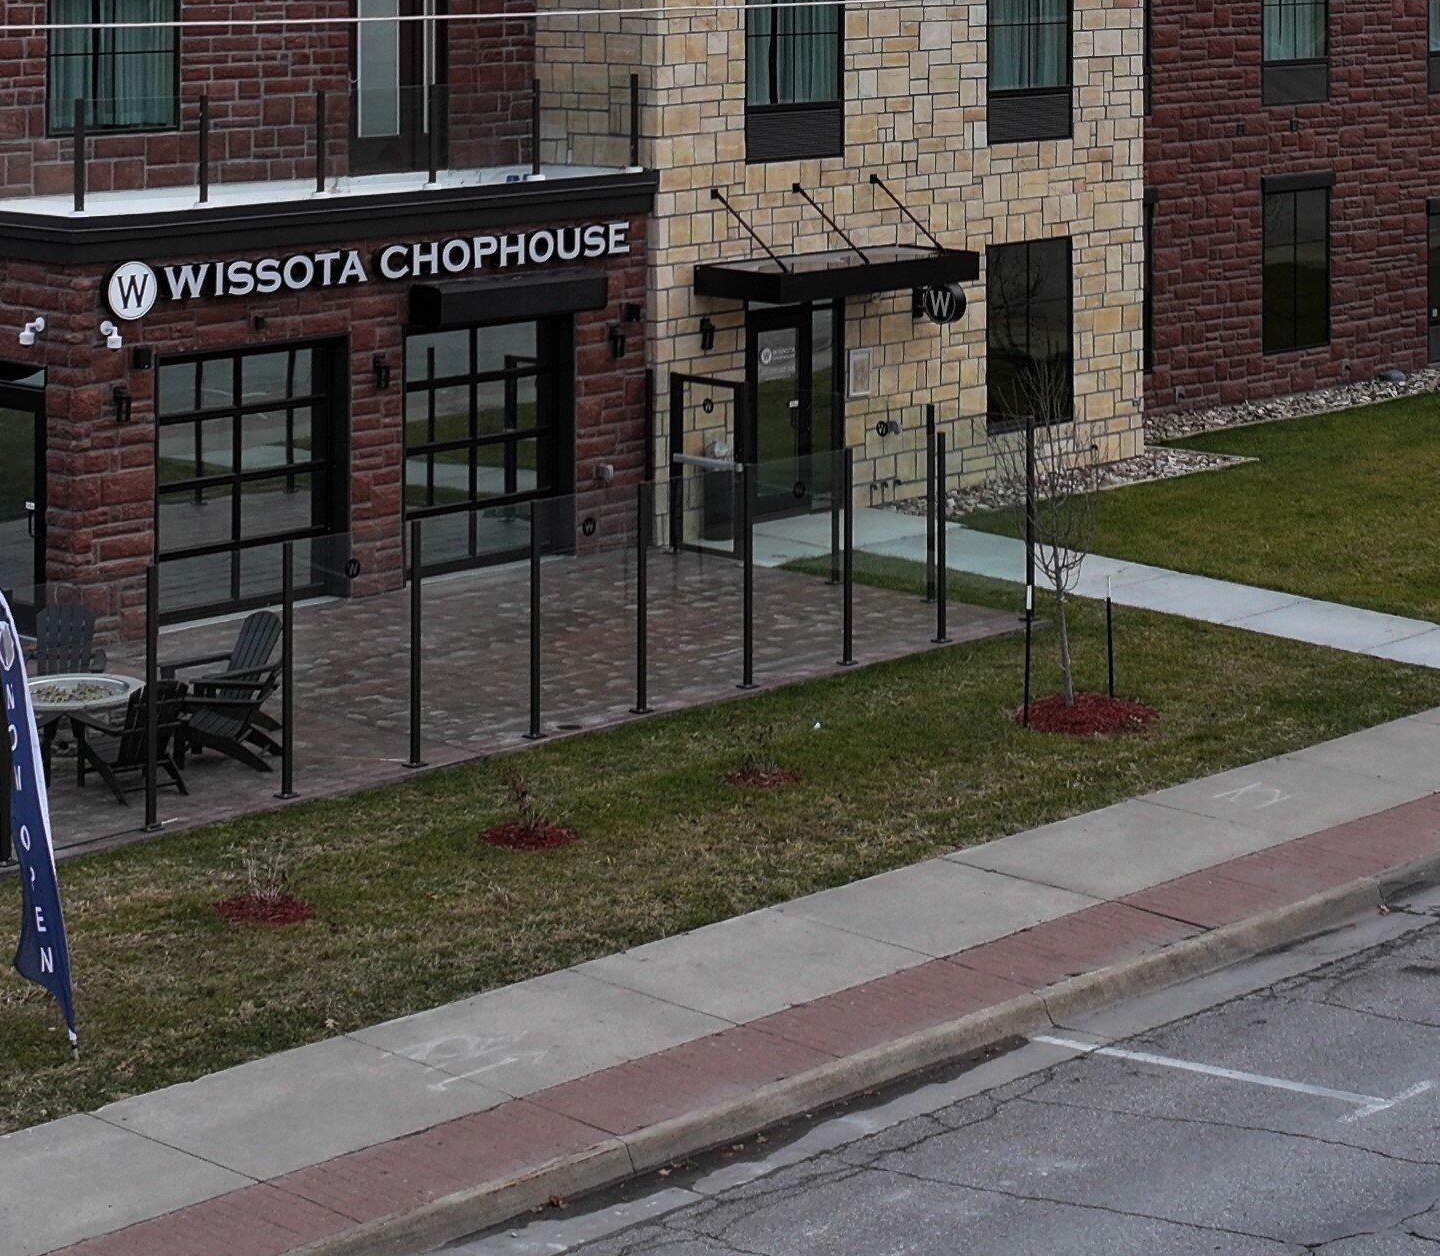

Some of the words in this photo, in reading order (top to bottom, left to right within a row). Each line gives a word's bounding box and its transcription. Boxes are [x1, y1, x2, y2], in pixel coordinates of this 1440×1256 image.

[114, 272, 149, 311] W
[163, 250, 368, 301] WISSOTA
[379, 221, 631, 280] CHOPHOUSE
[929, 290, 951, 318] W
